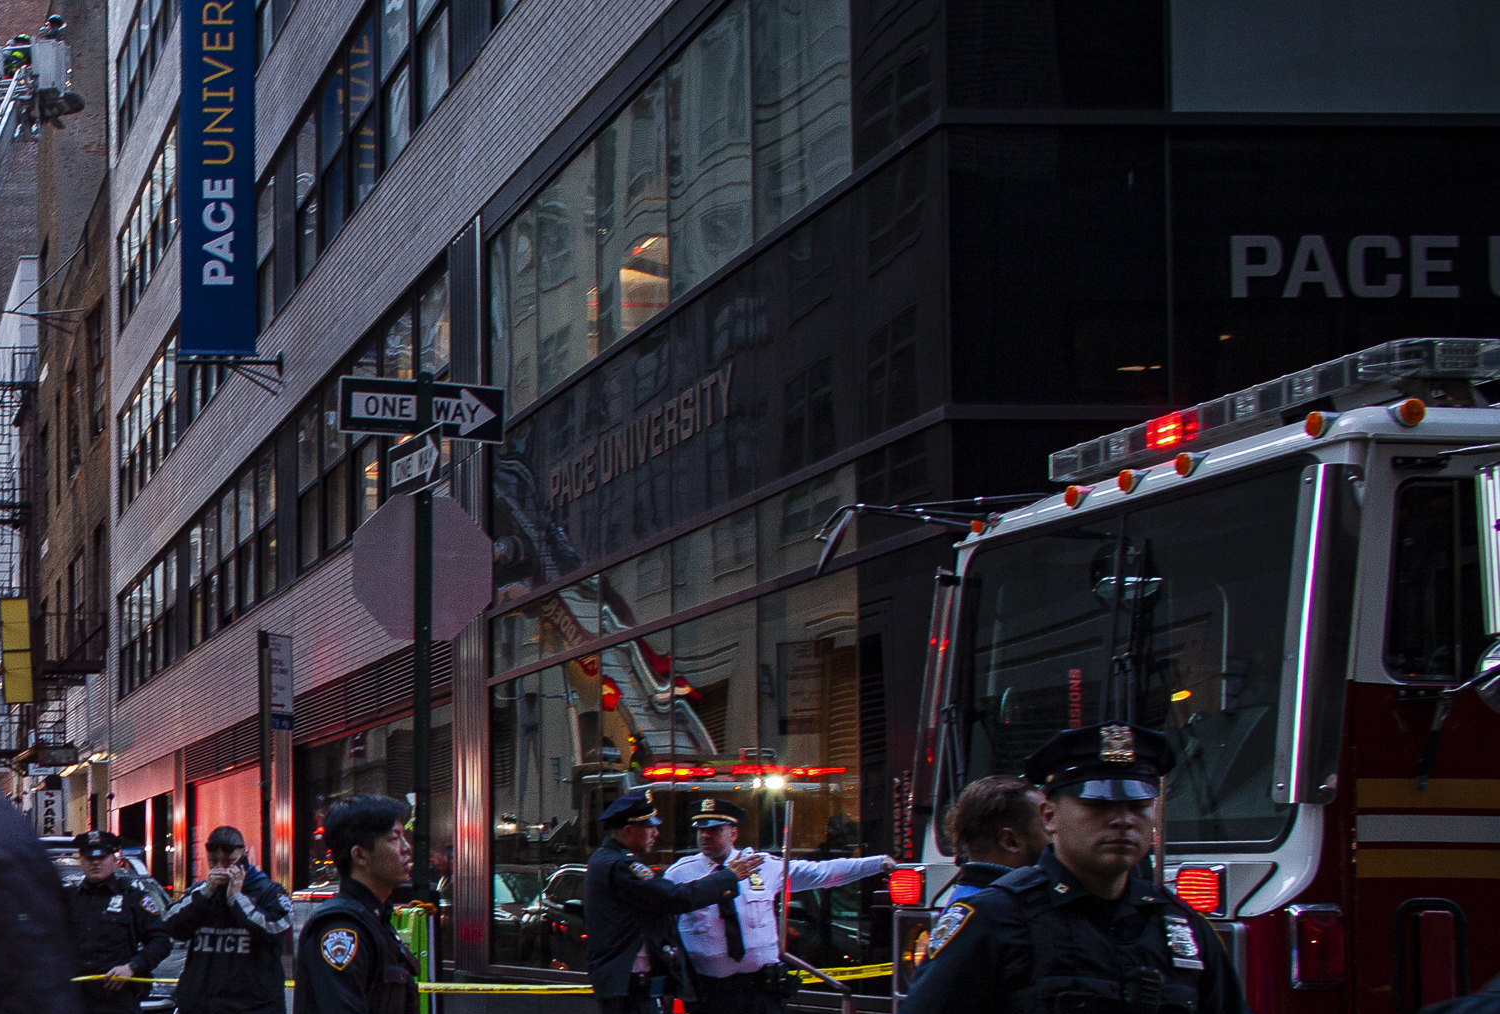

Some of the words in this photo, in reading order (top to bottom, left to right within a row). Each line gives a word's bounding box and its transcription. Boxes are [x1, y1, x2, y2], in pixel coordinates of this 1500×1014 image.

[202, 177, 235, 287] PACE
[1230, 235, 1460, 299] PACE
[365, 395, 412, 418] ONE
[434, 400, 481, 424] WAY
[549, 446, 597, 511] PACE
[600, 362, 735, 484] UNIVERSITY
[43, 800, 55, 834] PARK
[193, 934, 251, 954] OLICE
